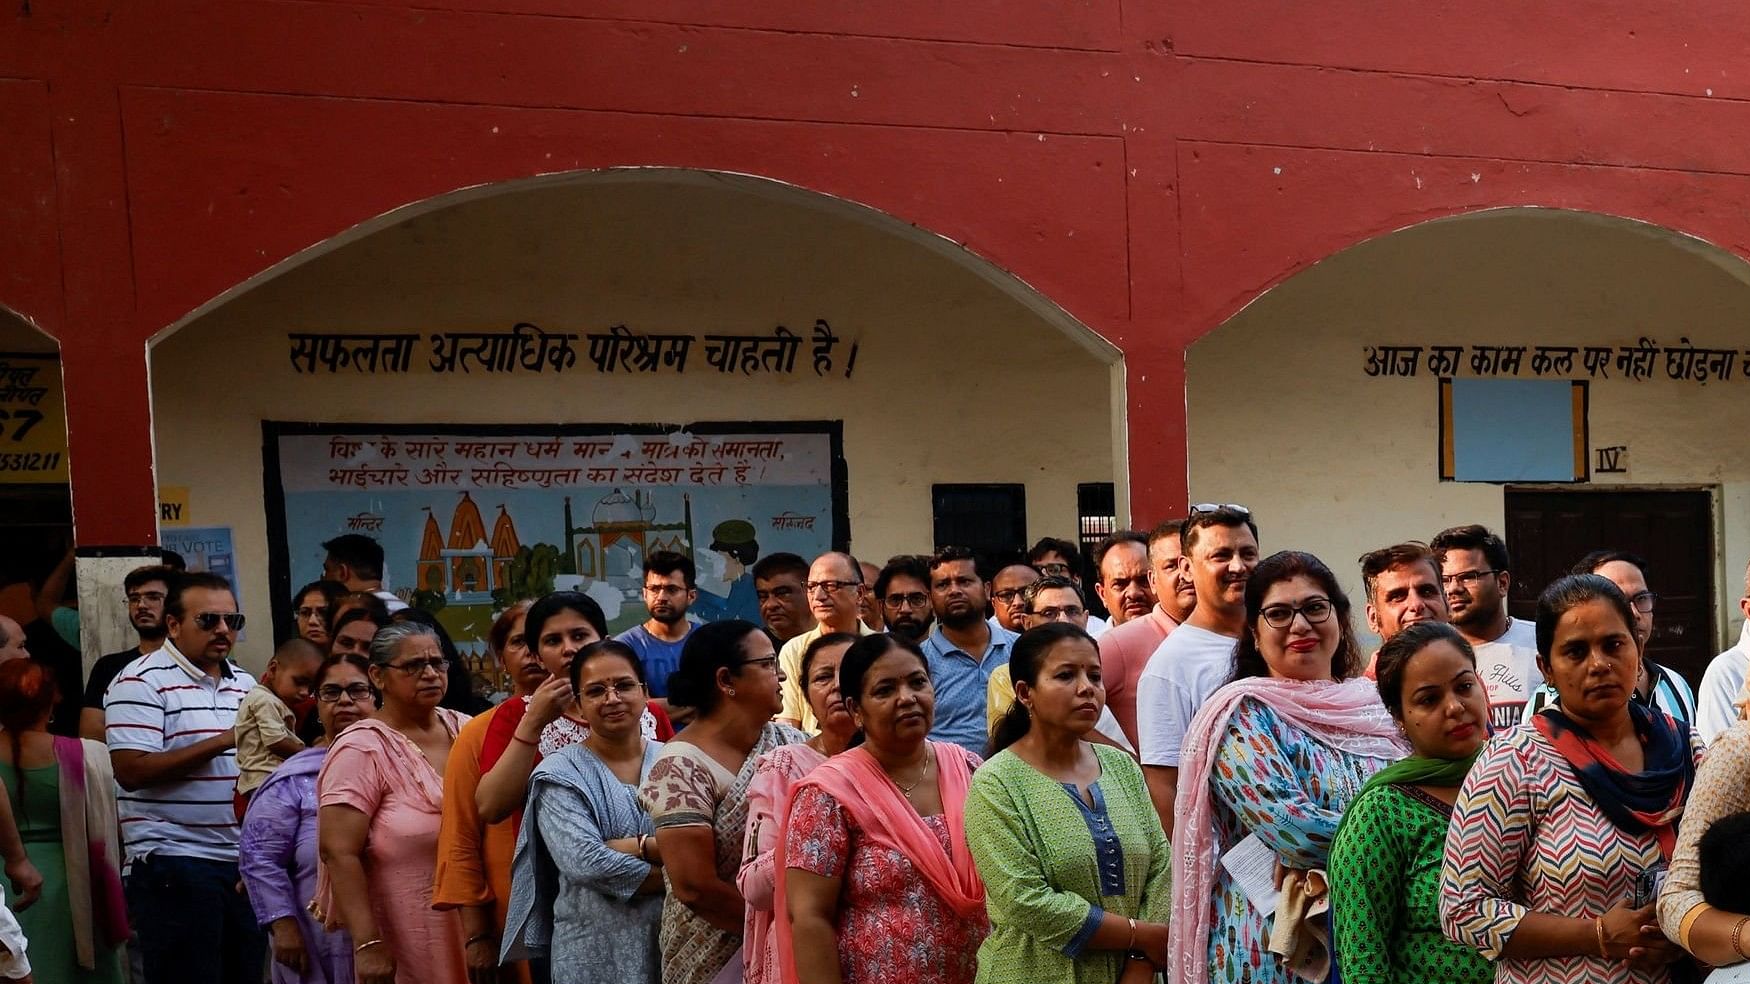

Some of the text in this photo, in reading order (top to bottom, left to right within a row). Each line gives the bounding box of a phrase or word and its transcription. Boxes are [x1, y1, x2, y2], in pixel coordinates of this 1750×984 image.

[288, 332, 420, 374] सफलता
[429, 321, 579, 374] अत्याधिक
[587, 324, 696, 374] परिश्रम
[704, 325, 803, 376] चाहती
[1362, 344, 1424, 378] आज
[1427, 345, 1464, 377] का
[1470, 344, 1527, 376] काम
[1531, 345, 1579, 377] कल
[1583, 346, 1613, 380] पर
[1616, 336, 1660, 382] नहीं
[1663, 336, 1738, 387] छोड़ना
[0, 452, 60, 471] 531211
[380, 436, 398, 459] के
[404, 437, 449, 460] सारे
[455, 441, 520, 462] महान
[524, 436, 562, 459] धर्म
[1594, 446, 1627, 473] IV
[328, 463, 410, 488] भाईचारे
[415, 462, 464, 486] और
[471, 462, 582, 488] सहिष्णुता
[586, 467, 618, 483] का
[623, 461, 684, 487] संदेश
[689, 462, 728, 486] देते
[159, 502, 182, 520] RY
[183, 541, 224, 553] VOTE
[1489, 663, 1522, 692] Hills
[1491, 706, 1521, 727] NIA
